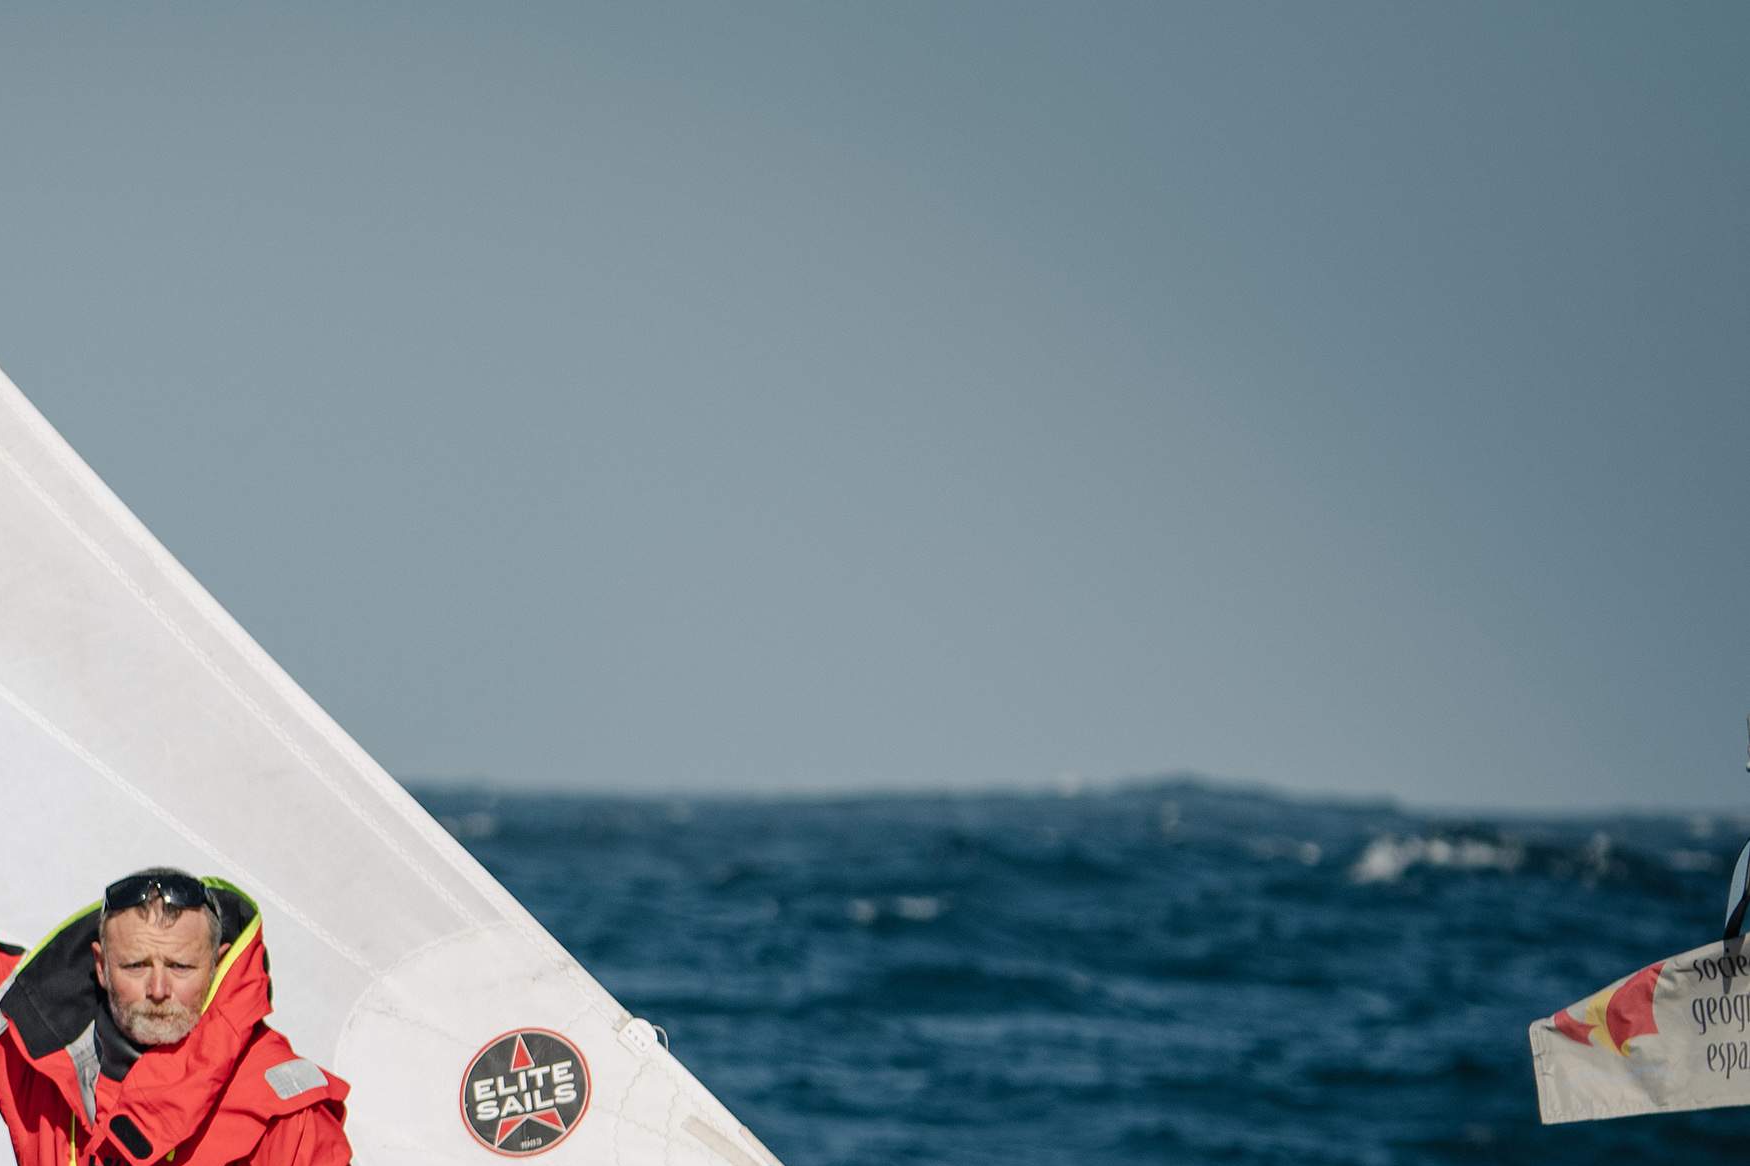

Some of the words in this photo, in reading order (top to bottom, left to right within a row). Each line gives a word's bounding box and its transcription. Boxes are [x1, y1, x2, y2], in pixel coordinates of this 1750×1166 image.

[1693, 946, 1750, 983] socie
[1706, 1040, 1750, 1080] espa
[473, 1060, 575, 1101] ELITE
[476, 1083, 577, 1122] SAILS
